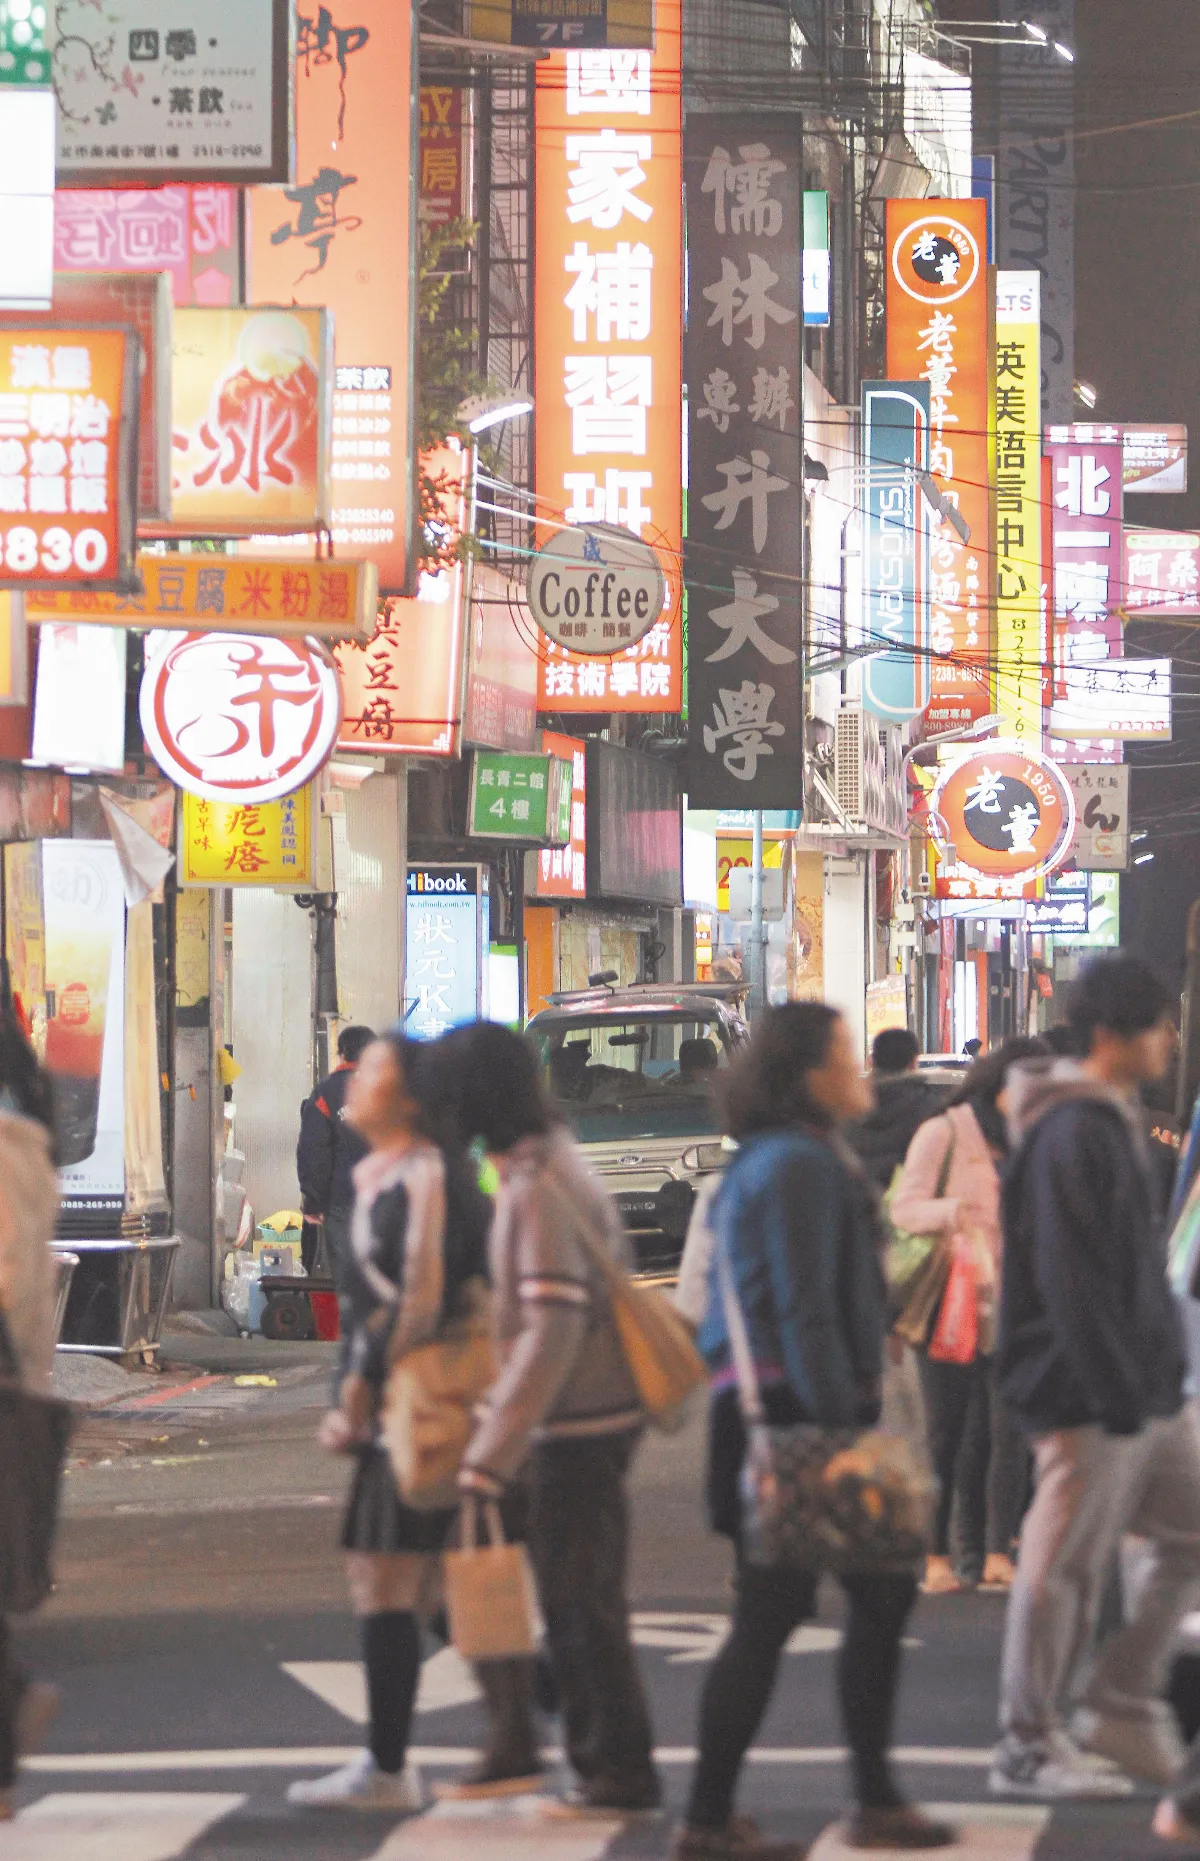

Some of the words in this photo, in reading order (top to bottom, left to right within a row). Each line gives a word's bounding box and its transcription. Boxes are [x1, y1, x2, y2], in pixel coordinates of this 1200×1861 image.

[536, 22, 586, 41] 7F
[169, 86, 224, 114] 茶飲
[911, 230, 961, 286] 老董
[947, 228, 970, 256] 1950
[564, 50, 654, 537] 國家補習班
[336, 366, 390, 390] 茶飲
[916, 310, 963, 653] 老董牛肉粉麵店
[996, 341, 1027, 600] 英美語言中心
[0, 525, 108, 574] 830
[240, 568, 350, 618] 米粉湯
[539, 572, 649, 618] Coffee
[559, 622, 588, 637] 咖啡
[545, 662, 671, 697] 技術學院
[480, 769, 545, 789] 長青二館
[1022, 764, 1057, 806] 1950
[193, 798, 213, 851] 古早味
[490, 798, 530, 820] 4樓
[963, 766, 1041, 855] 老董
[407, 872, 467, 892] Hibook
